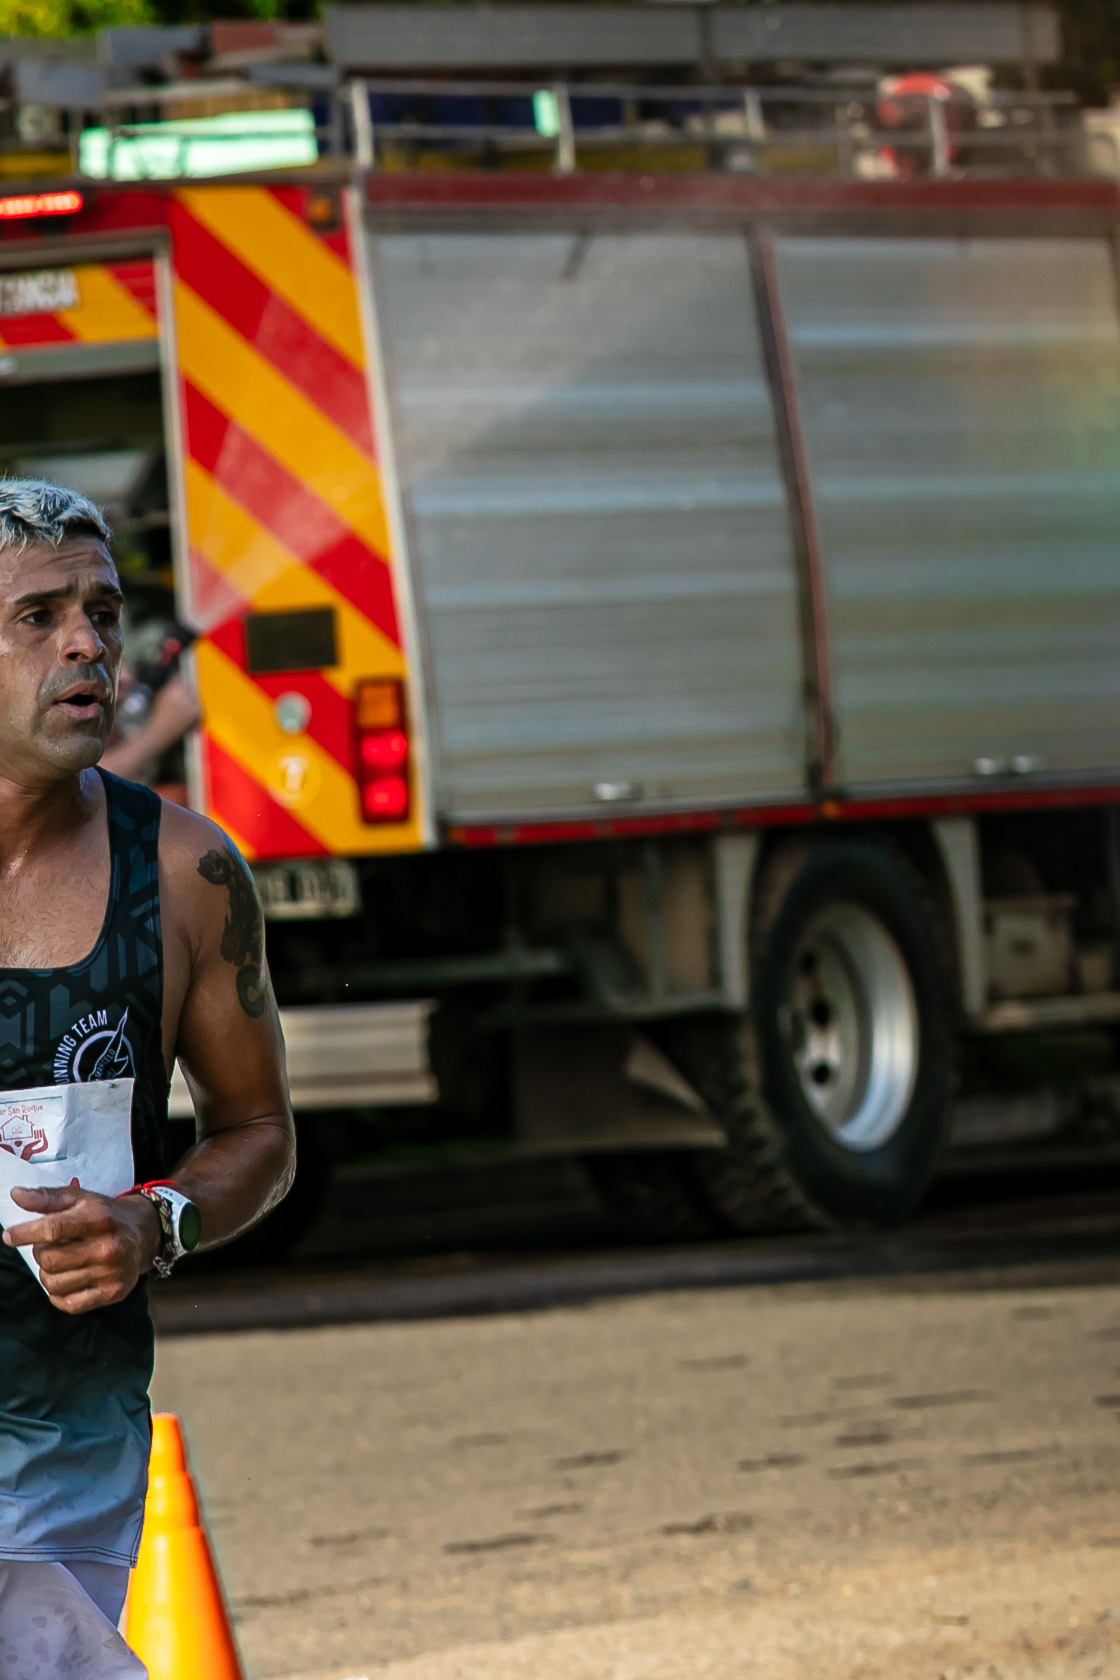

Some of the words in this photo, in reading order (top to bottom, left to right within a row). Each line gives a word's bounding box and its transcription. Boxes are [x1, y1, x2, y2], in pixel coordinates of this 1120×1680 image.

[53, 1034, 77, 1085] UNNING
[71, 1009, 108, 1038] TEAM
[8, 1106, 20, 1116] San
[22, 1104, 44, 1115] Roque
